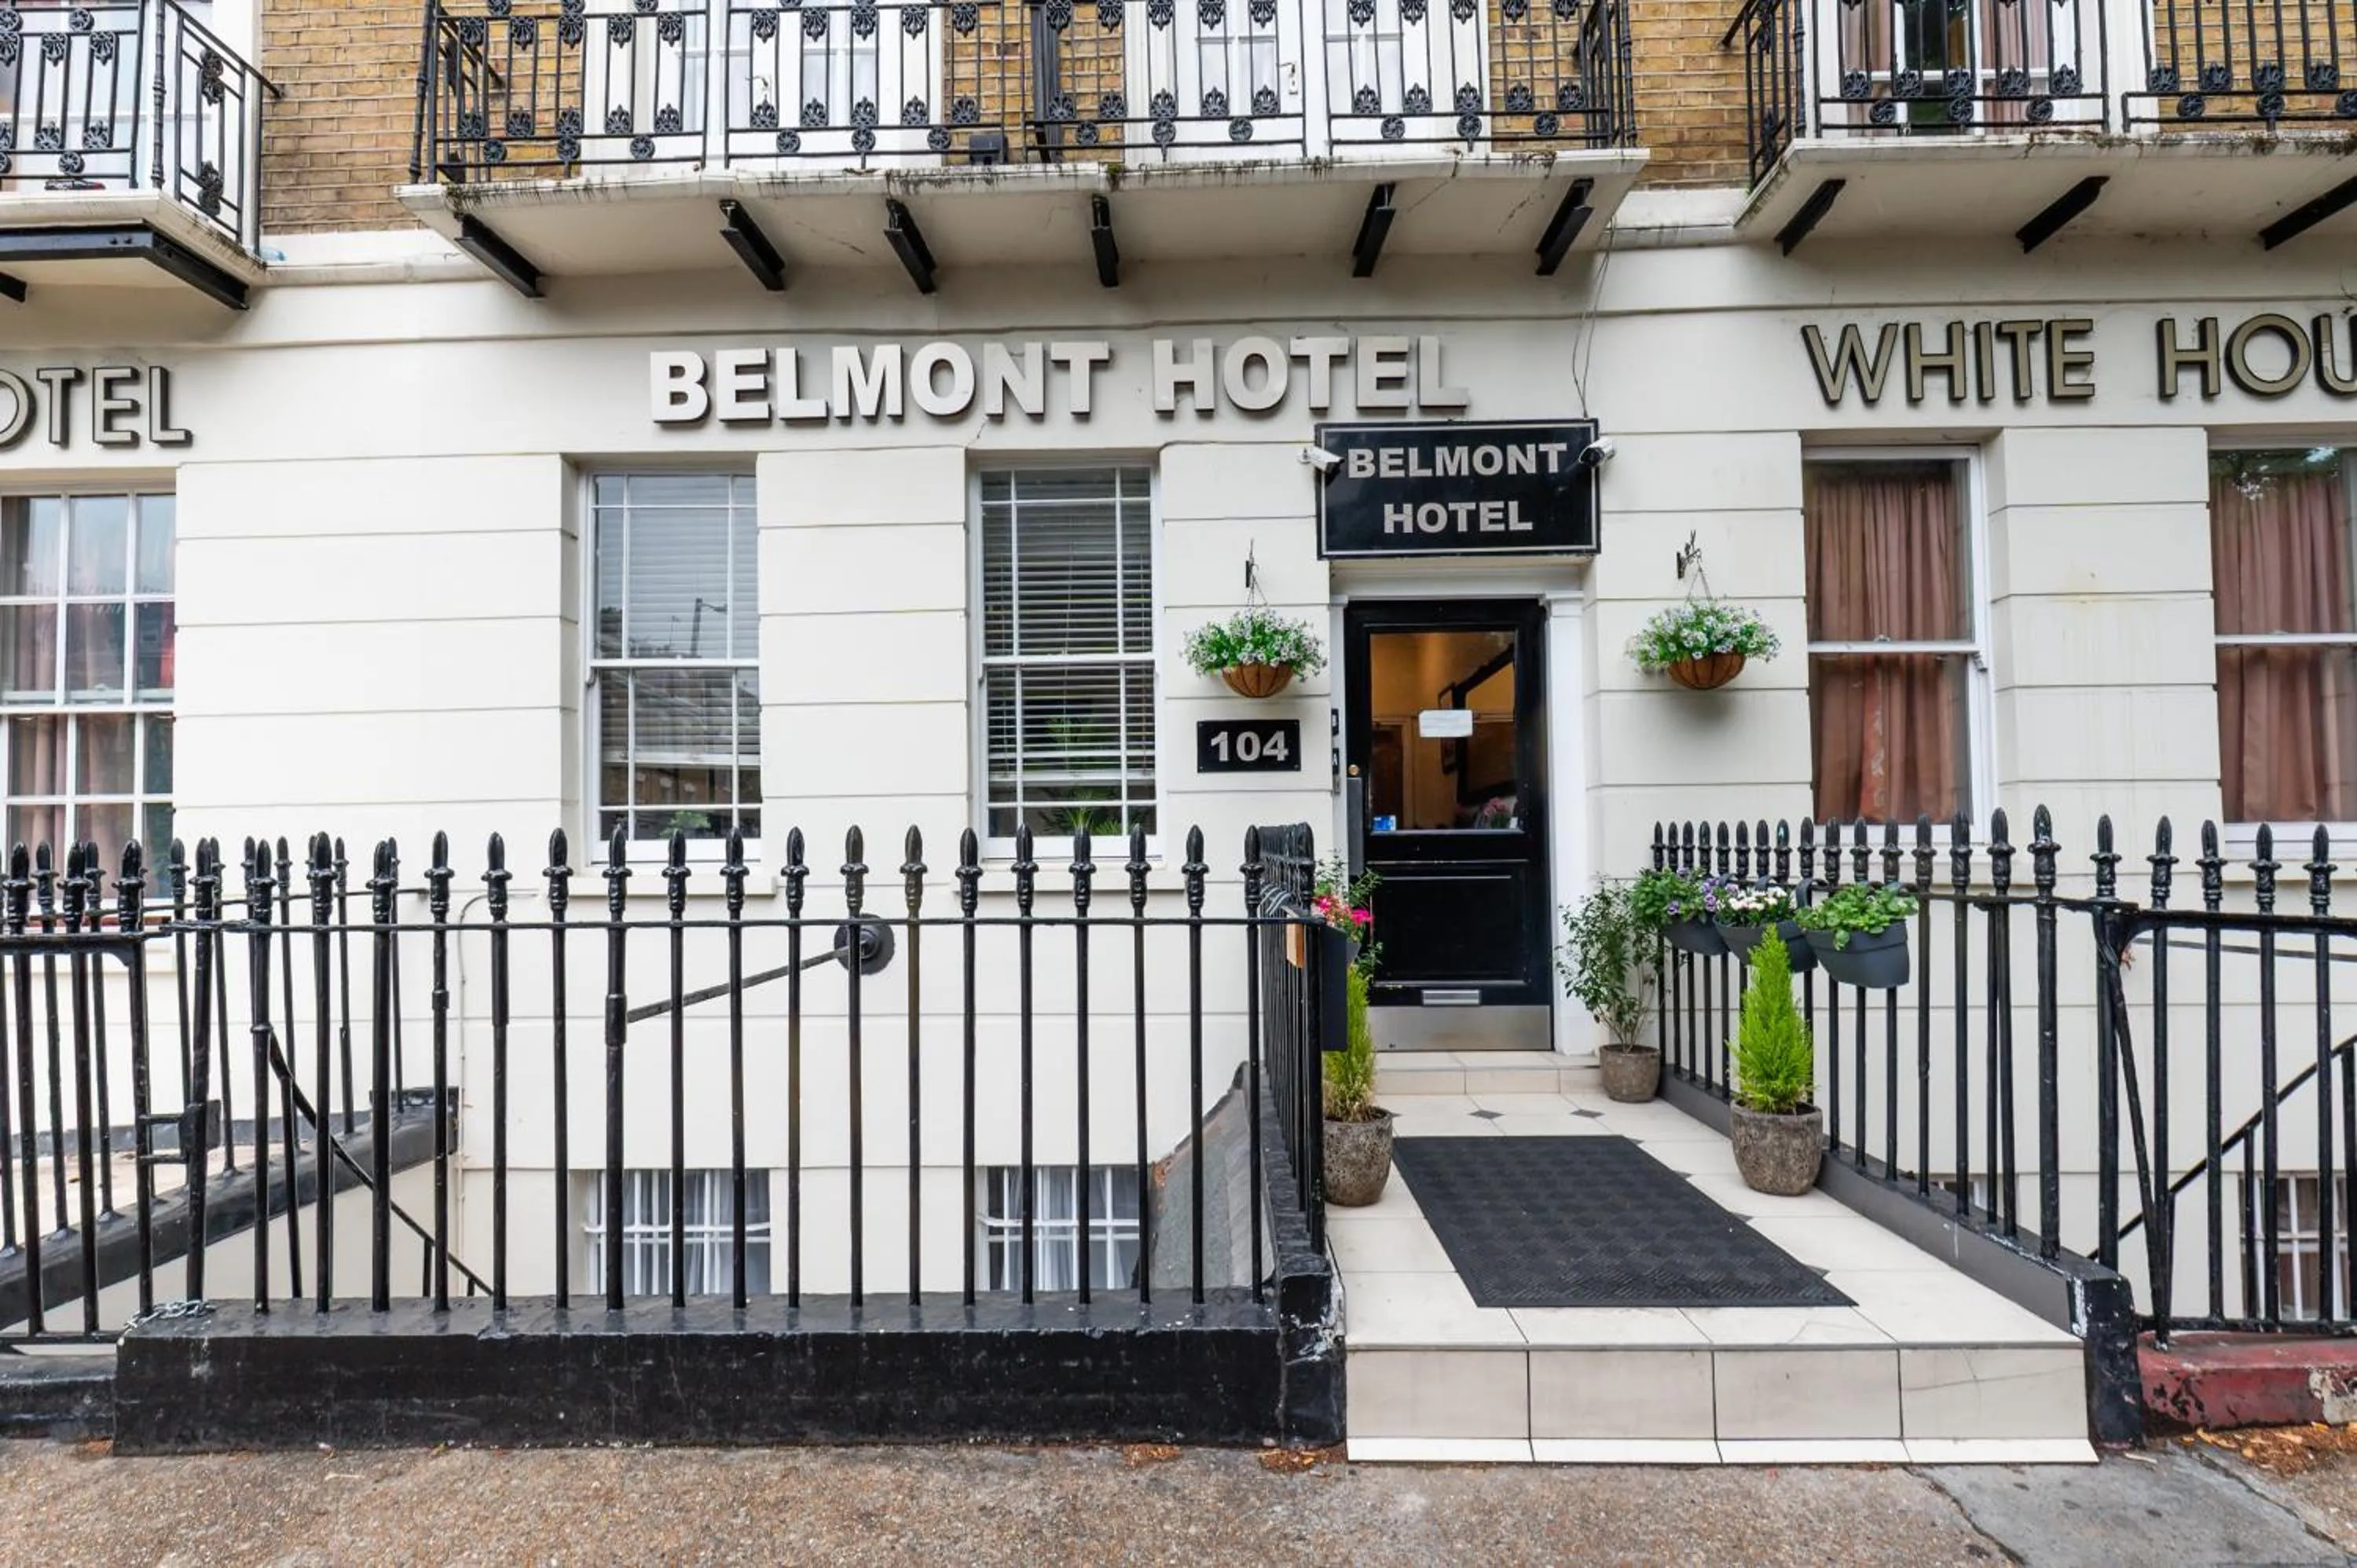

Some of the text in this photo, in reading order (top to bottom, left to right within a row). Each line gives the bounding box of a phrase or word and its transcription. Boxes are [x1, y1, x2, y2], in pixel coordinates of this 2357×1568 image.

[651, 335, 1469, 423] BELMONT HOTEL
[1802, 320, 2095, 405] WHITE
[1347, 442, 1567, 478] BELMONT
[1383, 501, 1534, 533] HOTEL
[1211, 731, 1289, 761] 104
